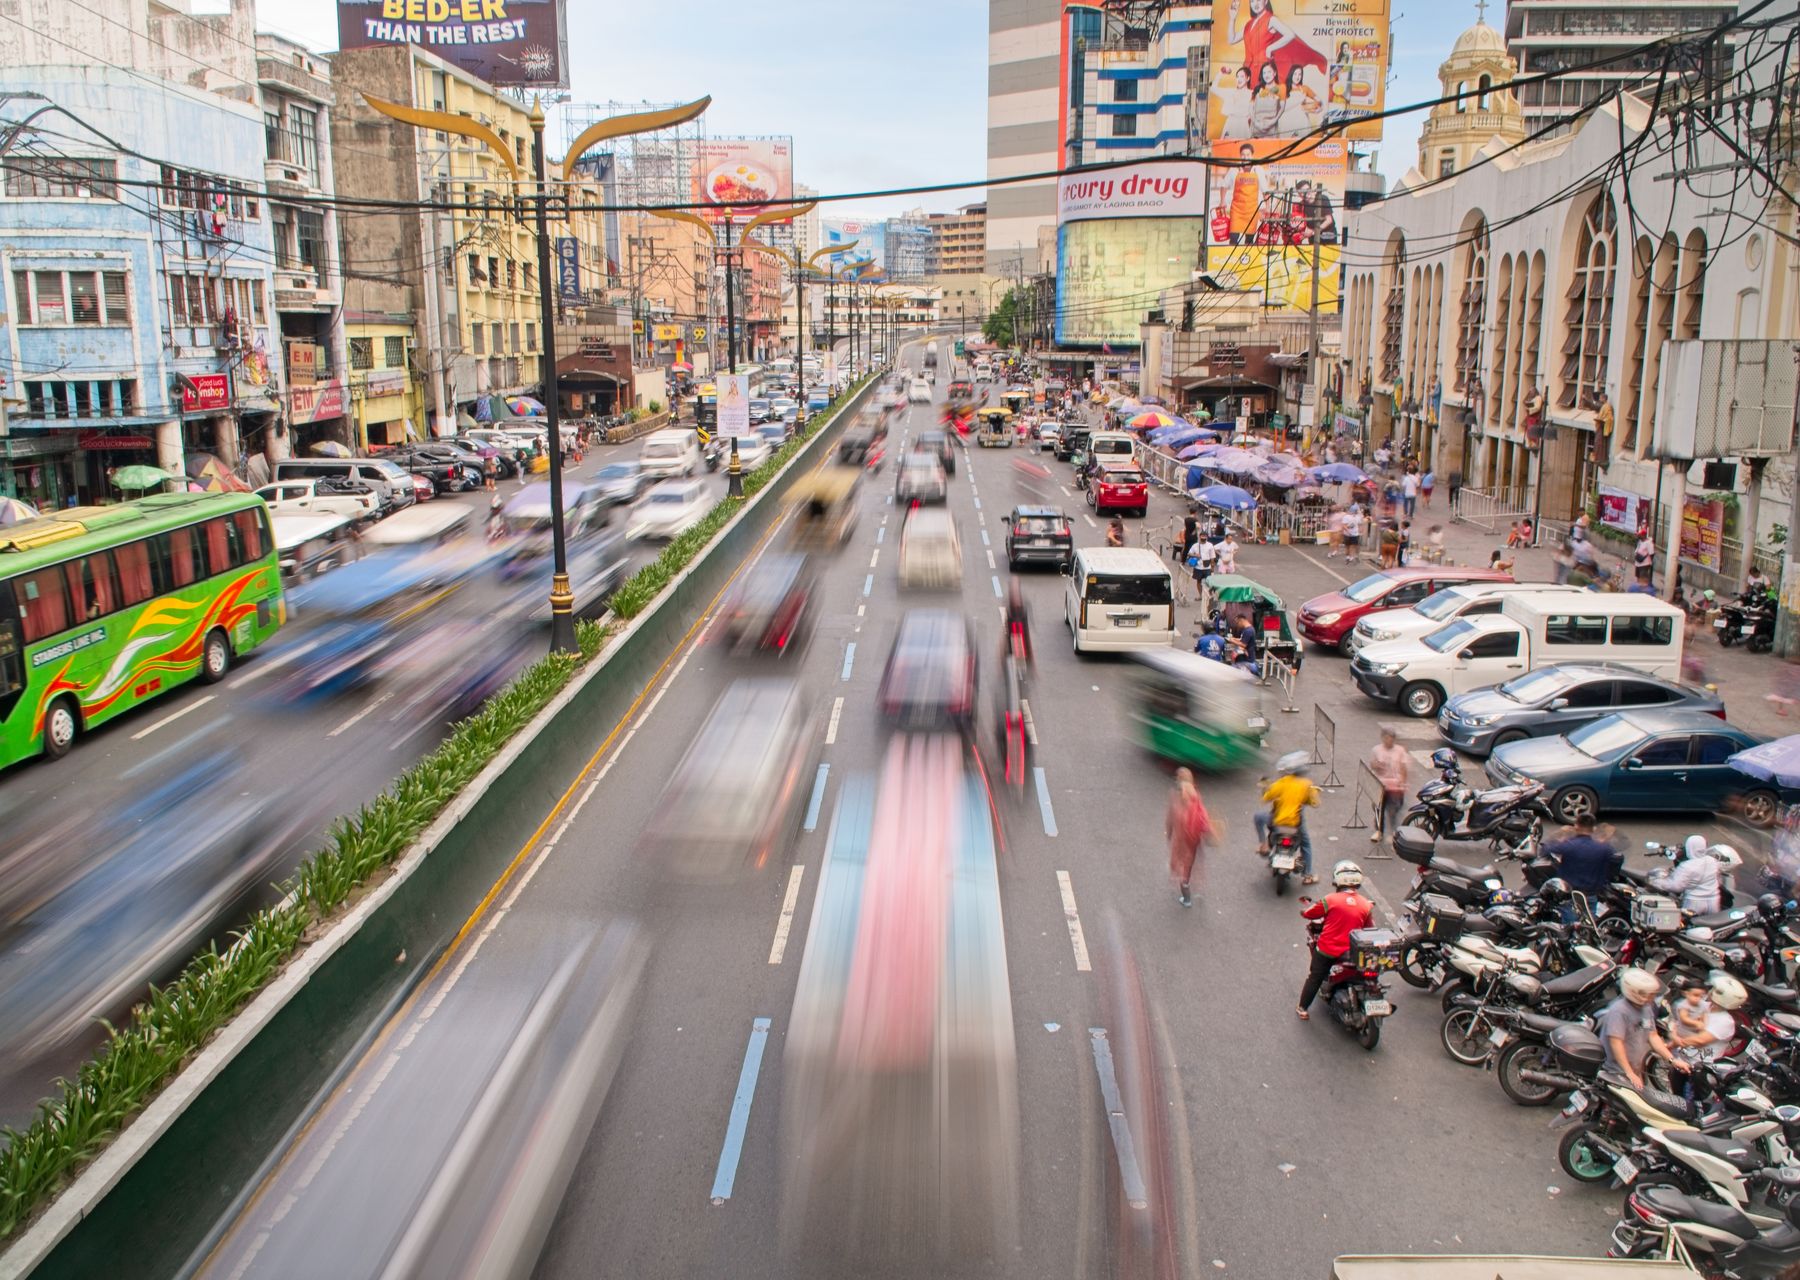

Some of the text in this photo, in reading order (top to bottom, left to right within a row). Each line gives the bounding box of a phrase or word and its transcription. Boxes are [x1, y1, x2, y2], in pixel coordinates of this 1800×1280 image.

[383, 0, 507, 21] BED-ER
[1332, 3, 1357, 12] ZINC
[366, 19, 525, 44] THAN THE REST
[1313, 28, 1375, 36] ZINC PROTECT
[1121, 174, 1189, 199] drug
[1104, 201, 1135, 209] LAGING
[293, 386, 314, 411] EM
[72, 635, 90, 650] LINE
